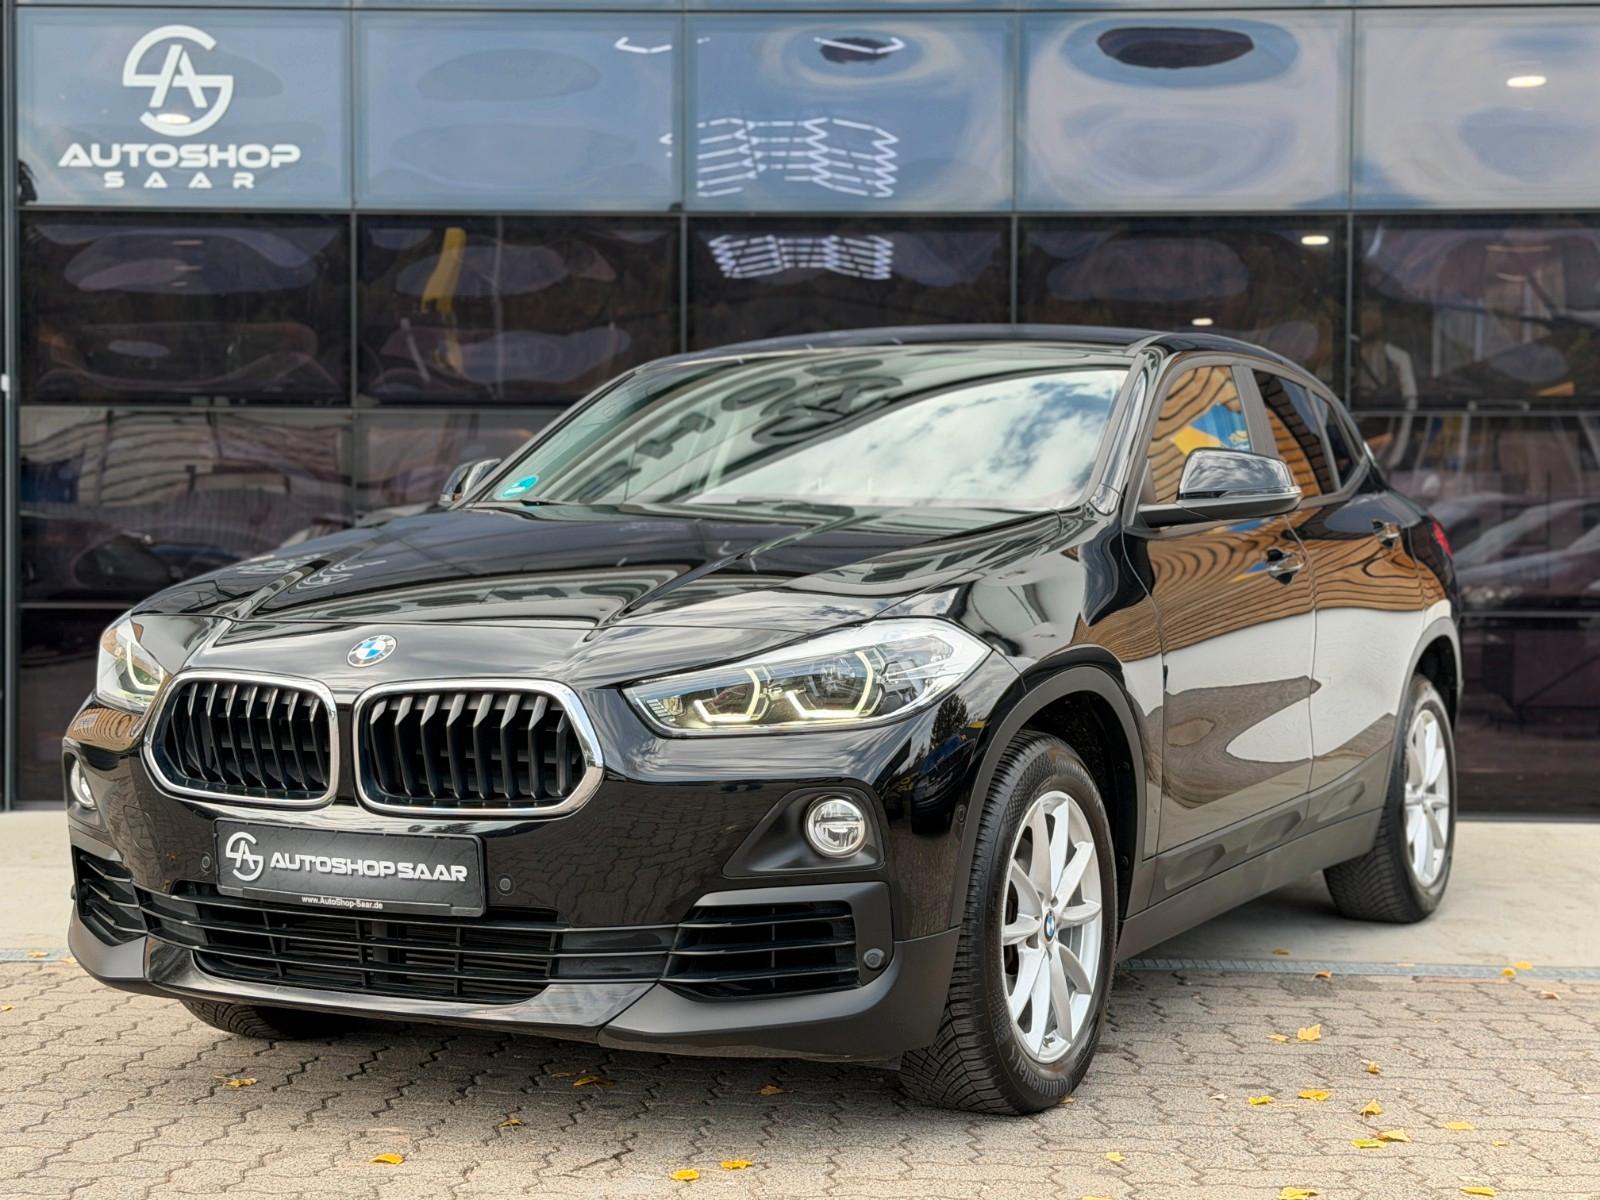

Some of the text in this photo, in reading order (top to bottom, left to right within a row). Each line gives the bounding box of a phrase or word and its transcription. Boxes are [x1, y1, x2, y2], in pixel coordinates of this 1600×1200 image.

[58, 143, 301, 169] AUTOSHOP
[103, 171, 255, 189] SAAR
[301, 896, 383, 910] www.AutoShop-Saar.de
